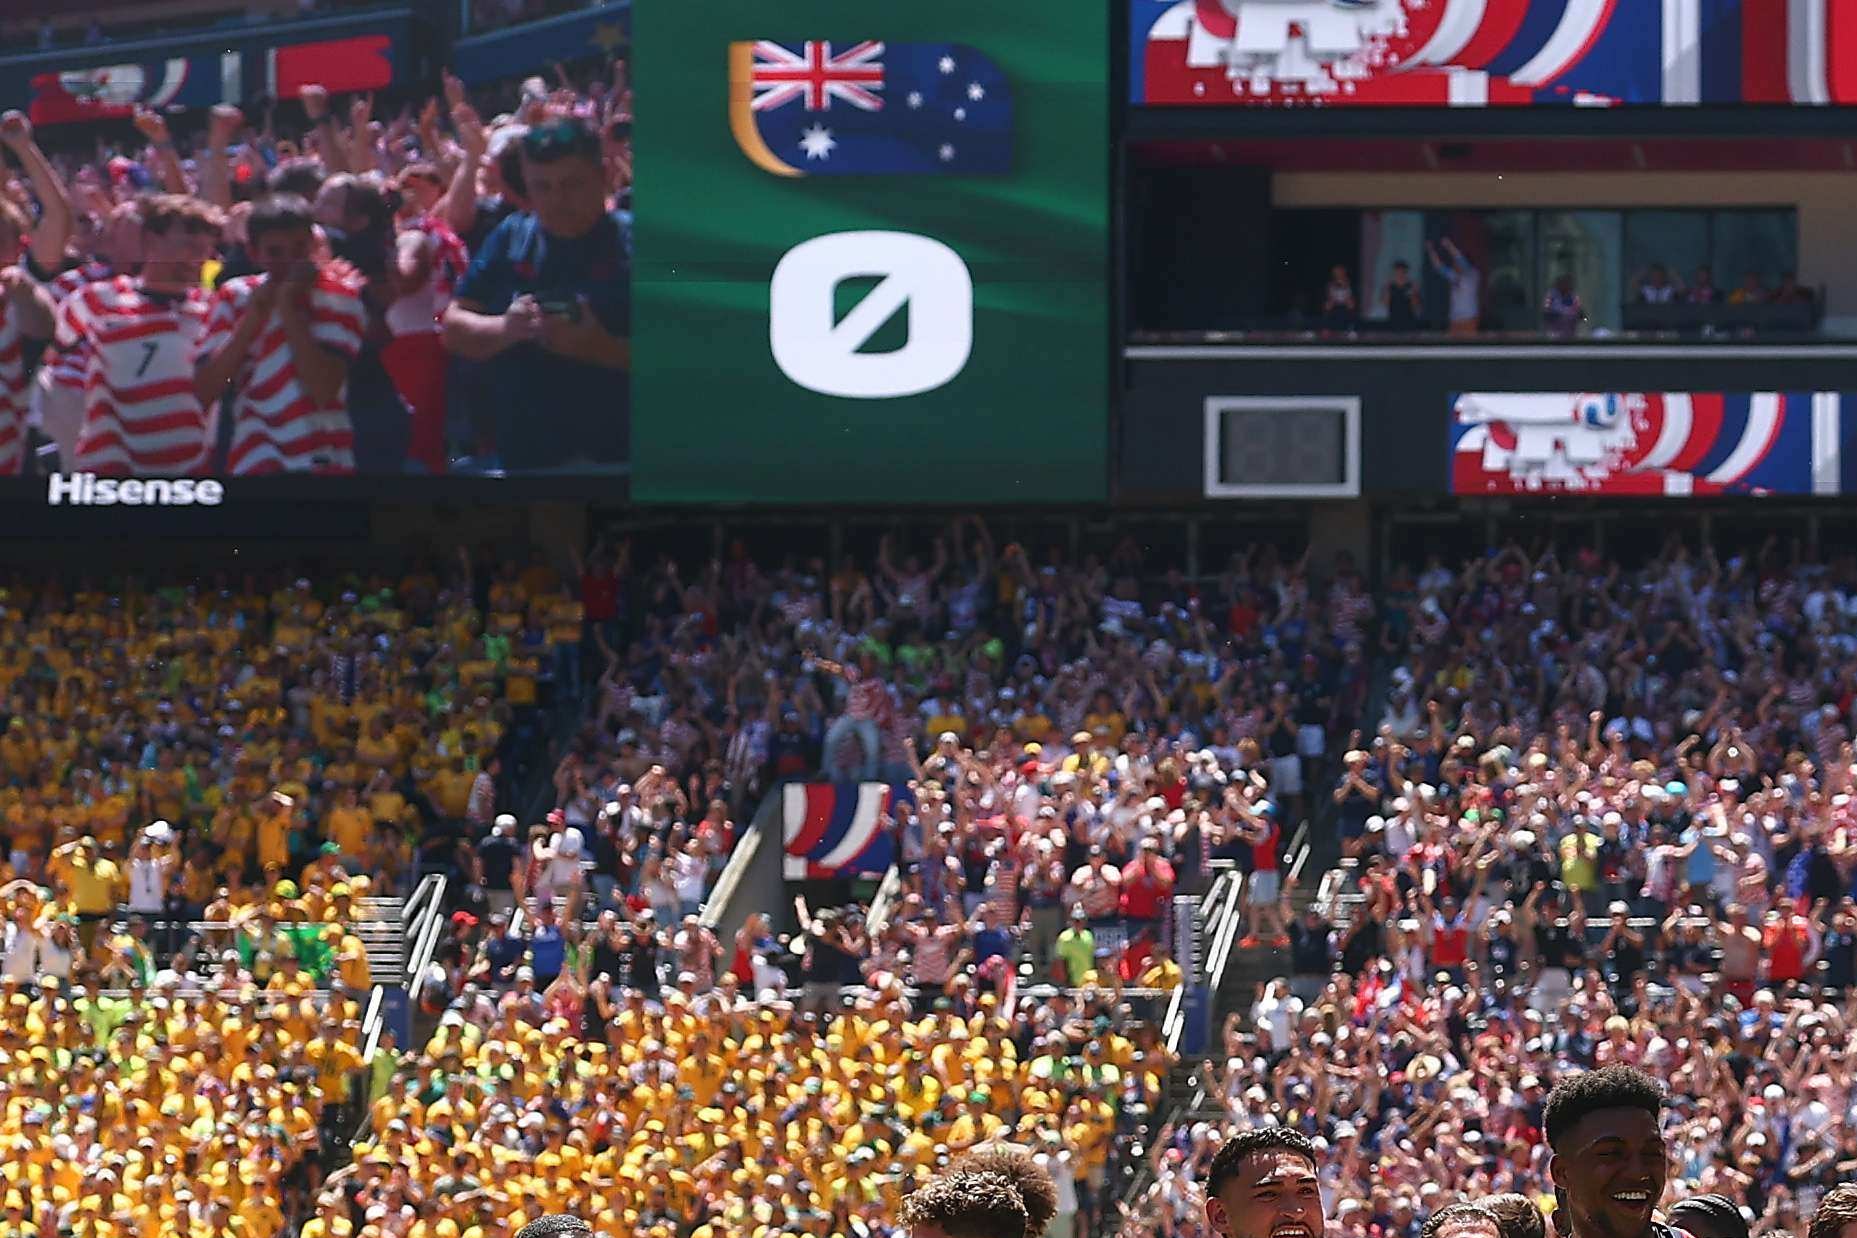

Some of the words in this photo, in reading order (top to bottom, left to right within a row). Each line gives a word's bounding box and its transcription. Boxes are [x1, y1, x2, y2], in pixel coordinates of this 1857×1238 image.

[769, 229, 974, 399] 0
[137, 342, 160, 378] 7
[48, 472, 224, 505] Hisense
